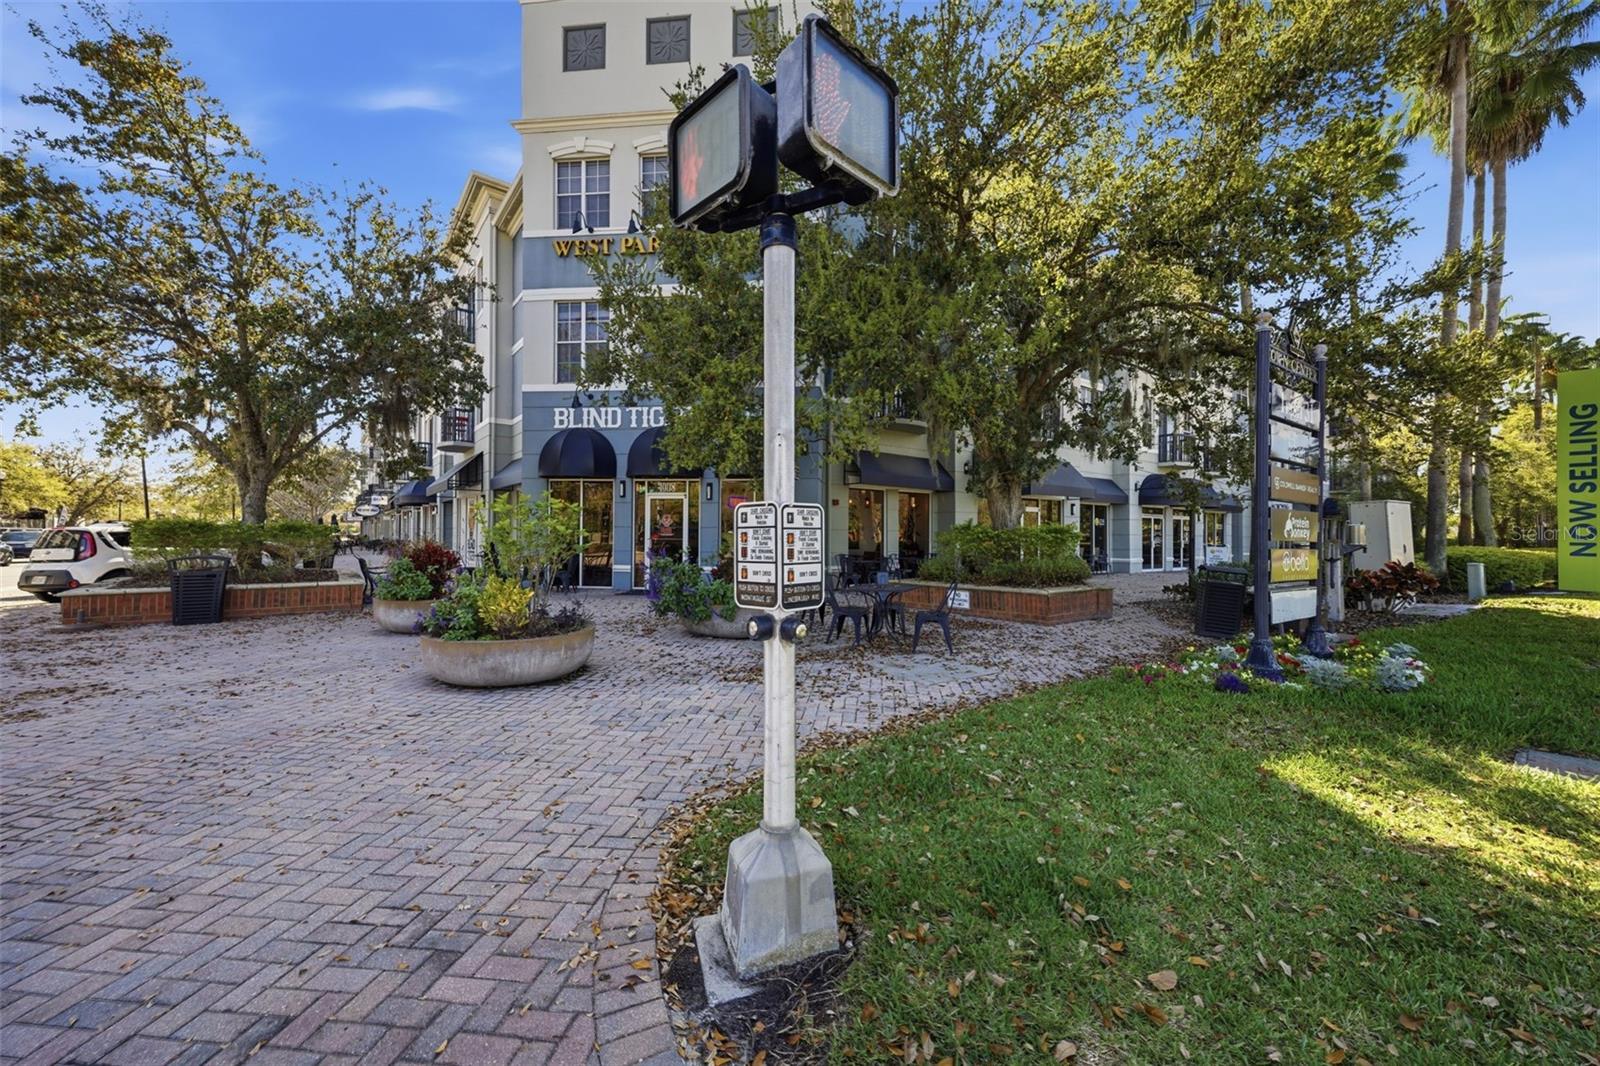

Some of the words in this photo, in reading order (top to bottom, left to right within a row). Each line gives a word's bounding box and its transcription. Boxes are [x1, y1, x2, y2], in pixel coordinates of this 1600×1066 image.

[552, 237, 614, 257] WEST
[621, 236, 661, 255] PAR
[553, 407, 622, 429] BLIND
[625, 406, 692, 428] TIG
[1569, 403, 1597, 493] SELLING
[1569, 500, 1597, 558] NOW
